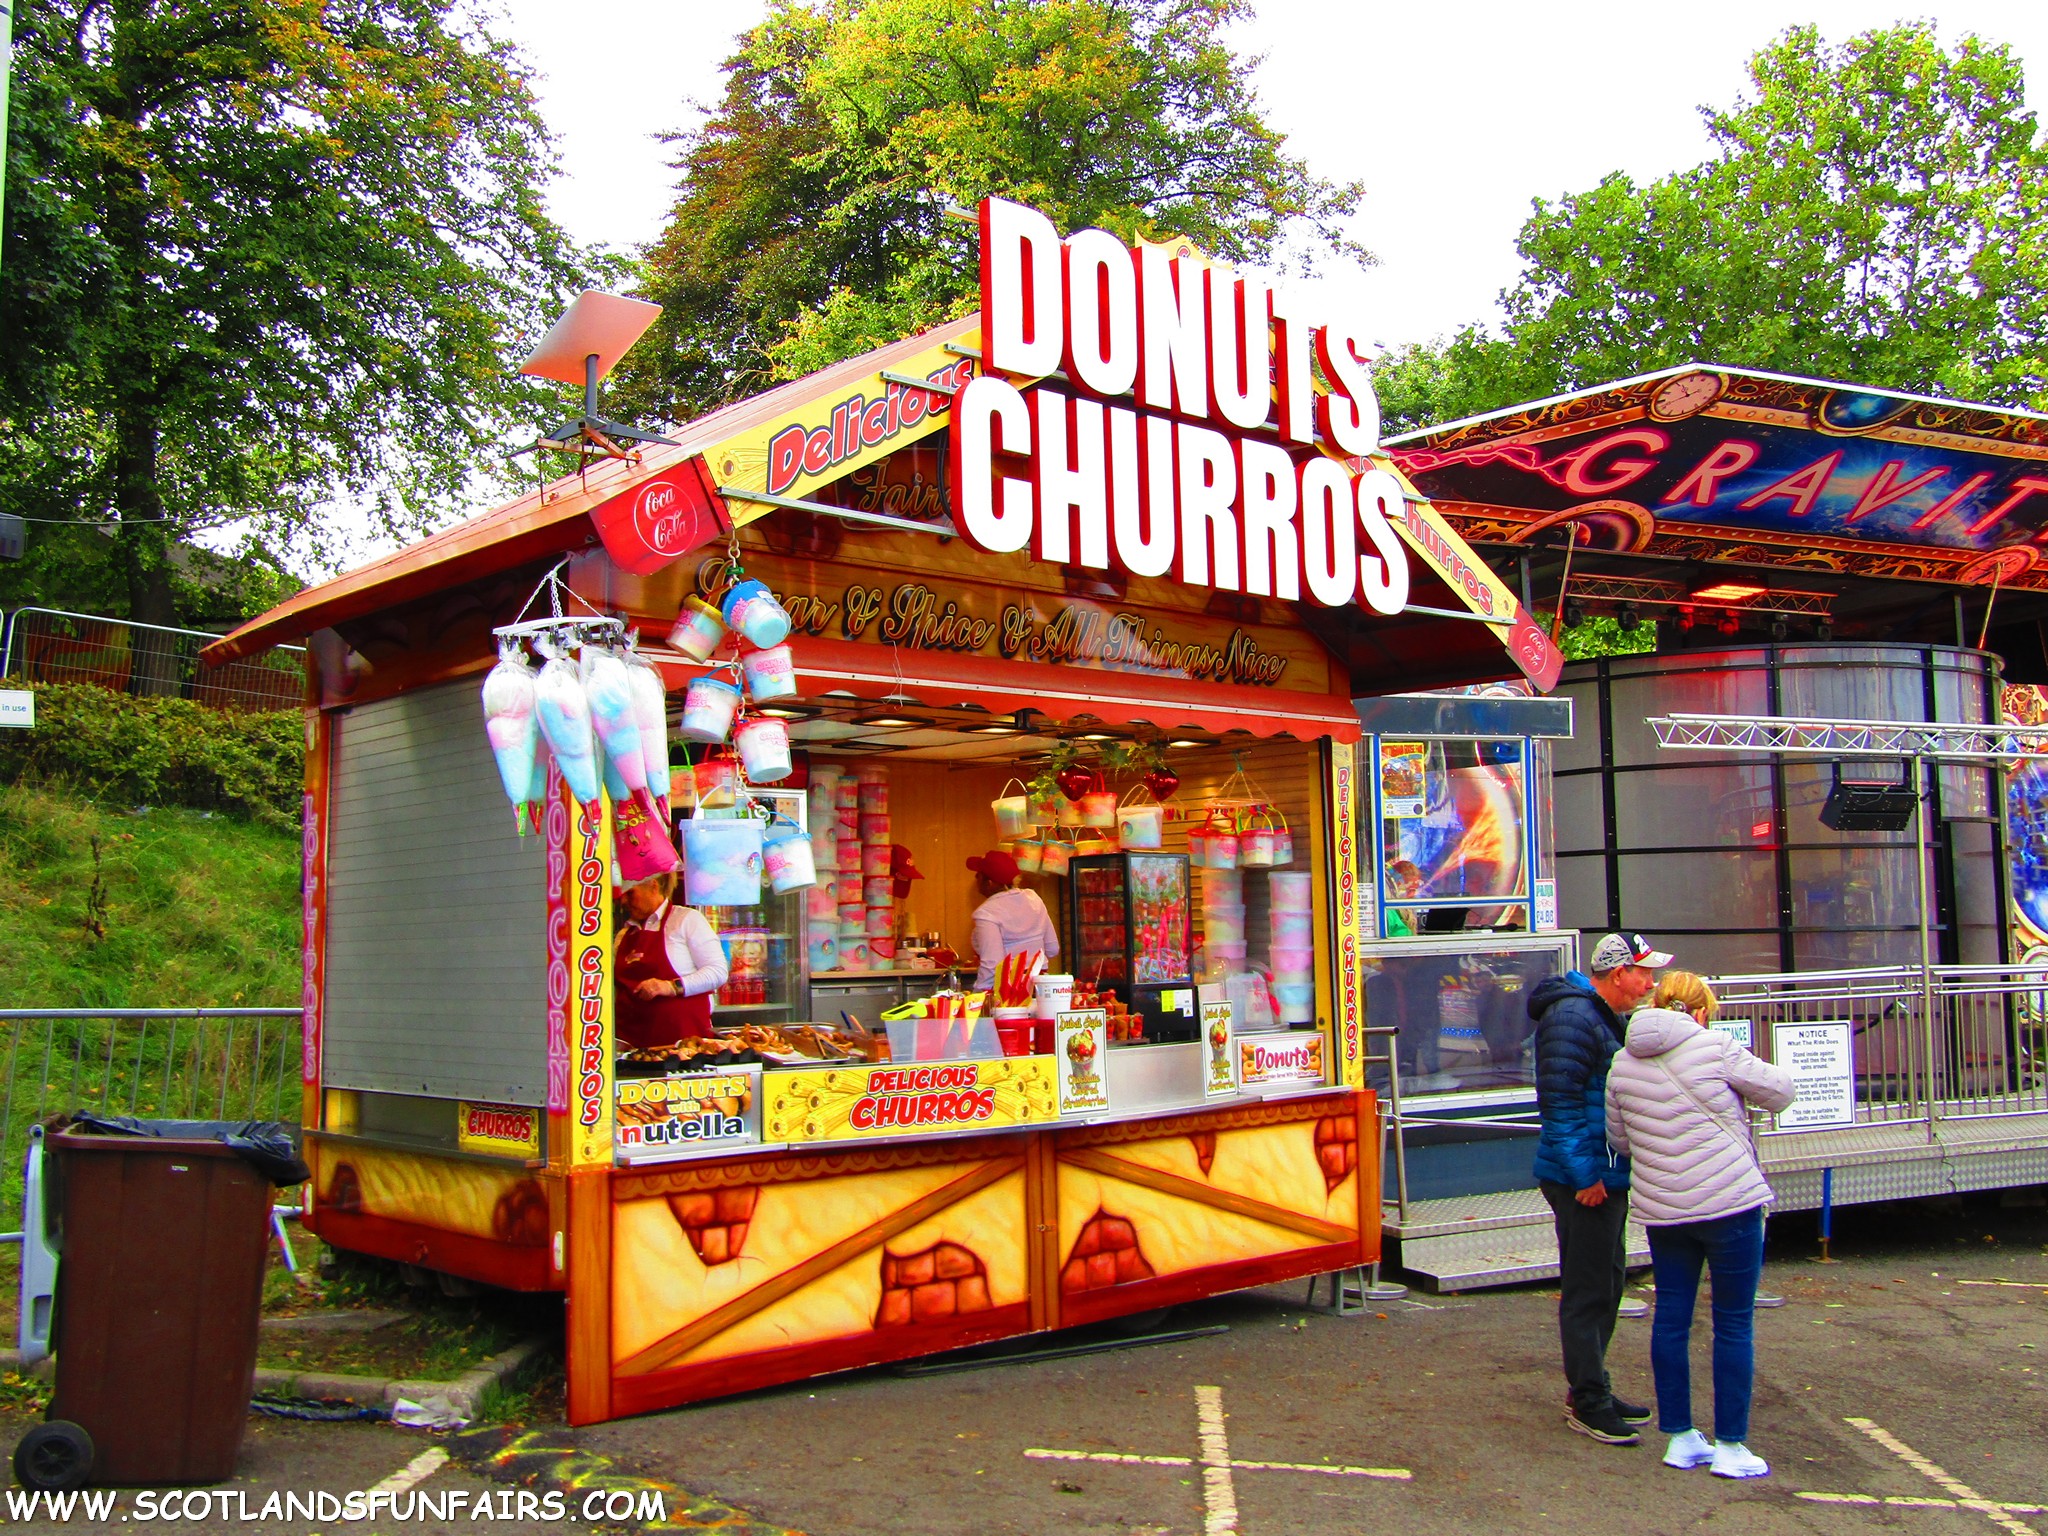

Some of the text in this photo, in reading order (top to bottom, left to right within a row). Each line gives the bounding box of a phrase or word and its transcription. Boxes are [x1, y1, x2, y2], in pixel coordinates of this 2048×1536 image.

[980, 196, 1382, 457] DONUTS
[767, 358, 975, 495] Delicious
[645, 486, 676, 519] Coca
[950, 376, 1409, 616] CHURROS
[1564, 429, 2048, 540] GRAVIT
[655, 508, 688, 549] Cola
[1402, 500, 1494, 615] hurros
[848, 585, 883, 633] &
[886, 584, 995, 649] Spice
[1002, 606, 1033, 648] &
[1033, 608, 1103, 654] All
[1104, 612, 1214, 678] Things
[1215, 629, 1286, 682] Nice
[303, 794, 318, 1080] LOLLIPOPS
[547, 752, 571, 1108] POP CORN
[1337, 766, 1358, 1061] DELICIOUS CHURROS
[579, 946, 604, 1126] CHURROS
[1254, 1046, 1310, 1070] Donuts
[1798, 1030, 1828, 1038] NOTICE
[619, 1075, 747, 1105] DONUTS
[666, 1100, 701, 1114] with
[849, 1087, 997, 1131] CHURROS
[867, 1064, 979, 1095] DELICIOUS
[467, 1108, 532, 1142] CHURROS
[620, 1113, 745, 1145] nutella
